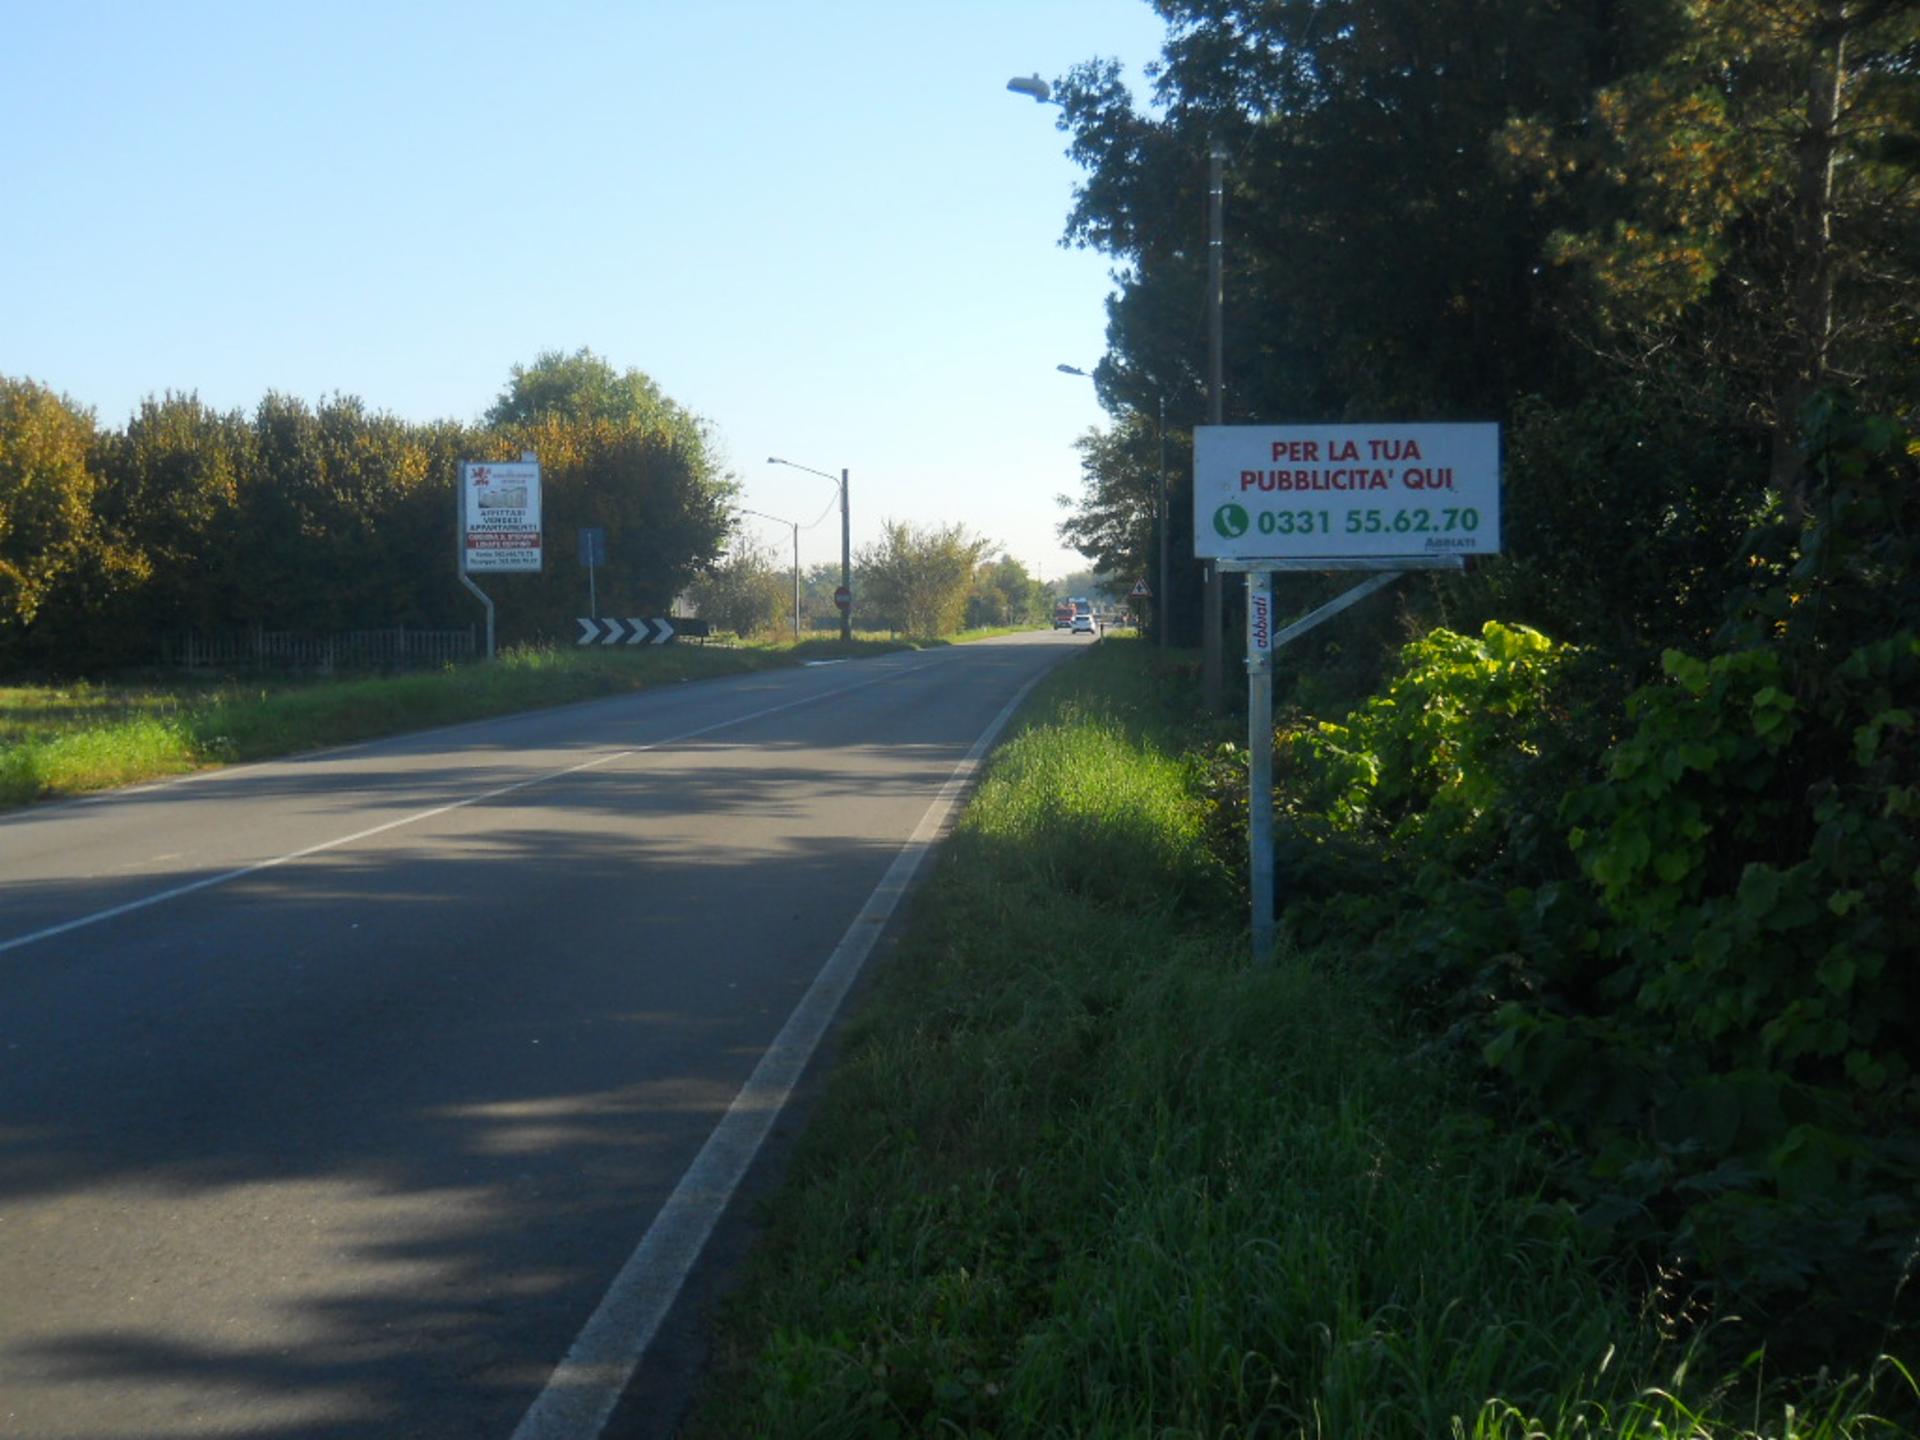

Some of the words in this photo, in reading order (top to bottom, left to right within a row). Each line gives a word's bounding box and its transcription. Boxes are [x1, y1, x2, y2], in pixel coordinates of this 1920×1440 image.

[1272, 441, 1319, 462] PER
[1328, 441, 1360, 461] LA
[1368, 439, 1421, 461] TUA
[1241, 469, 1394, 492] PUBBLICITA'
[1402, 468, 1453, 490] QUI
[1257, 510, 1329, 534] 0331
[1345, 507, 1479, 533] 55.62.70
